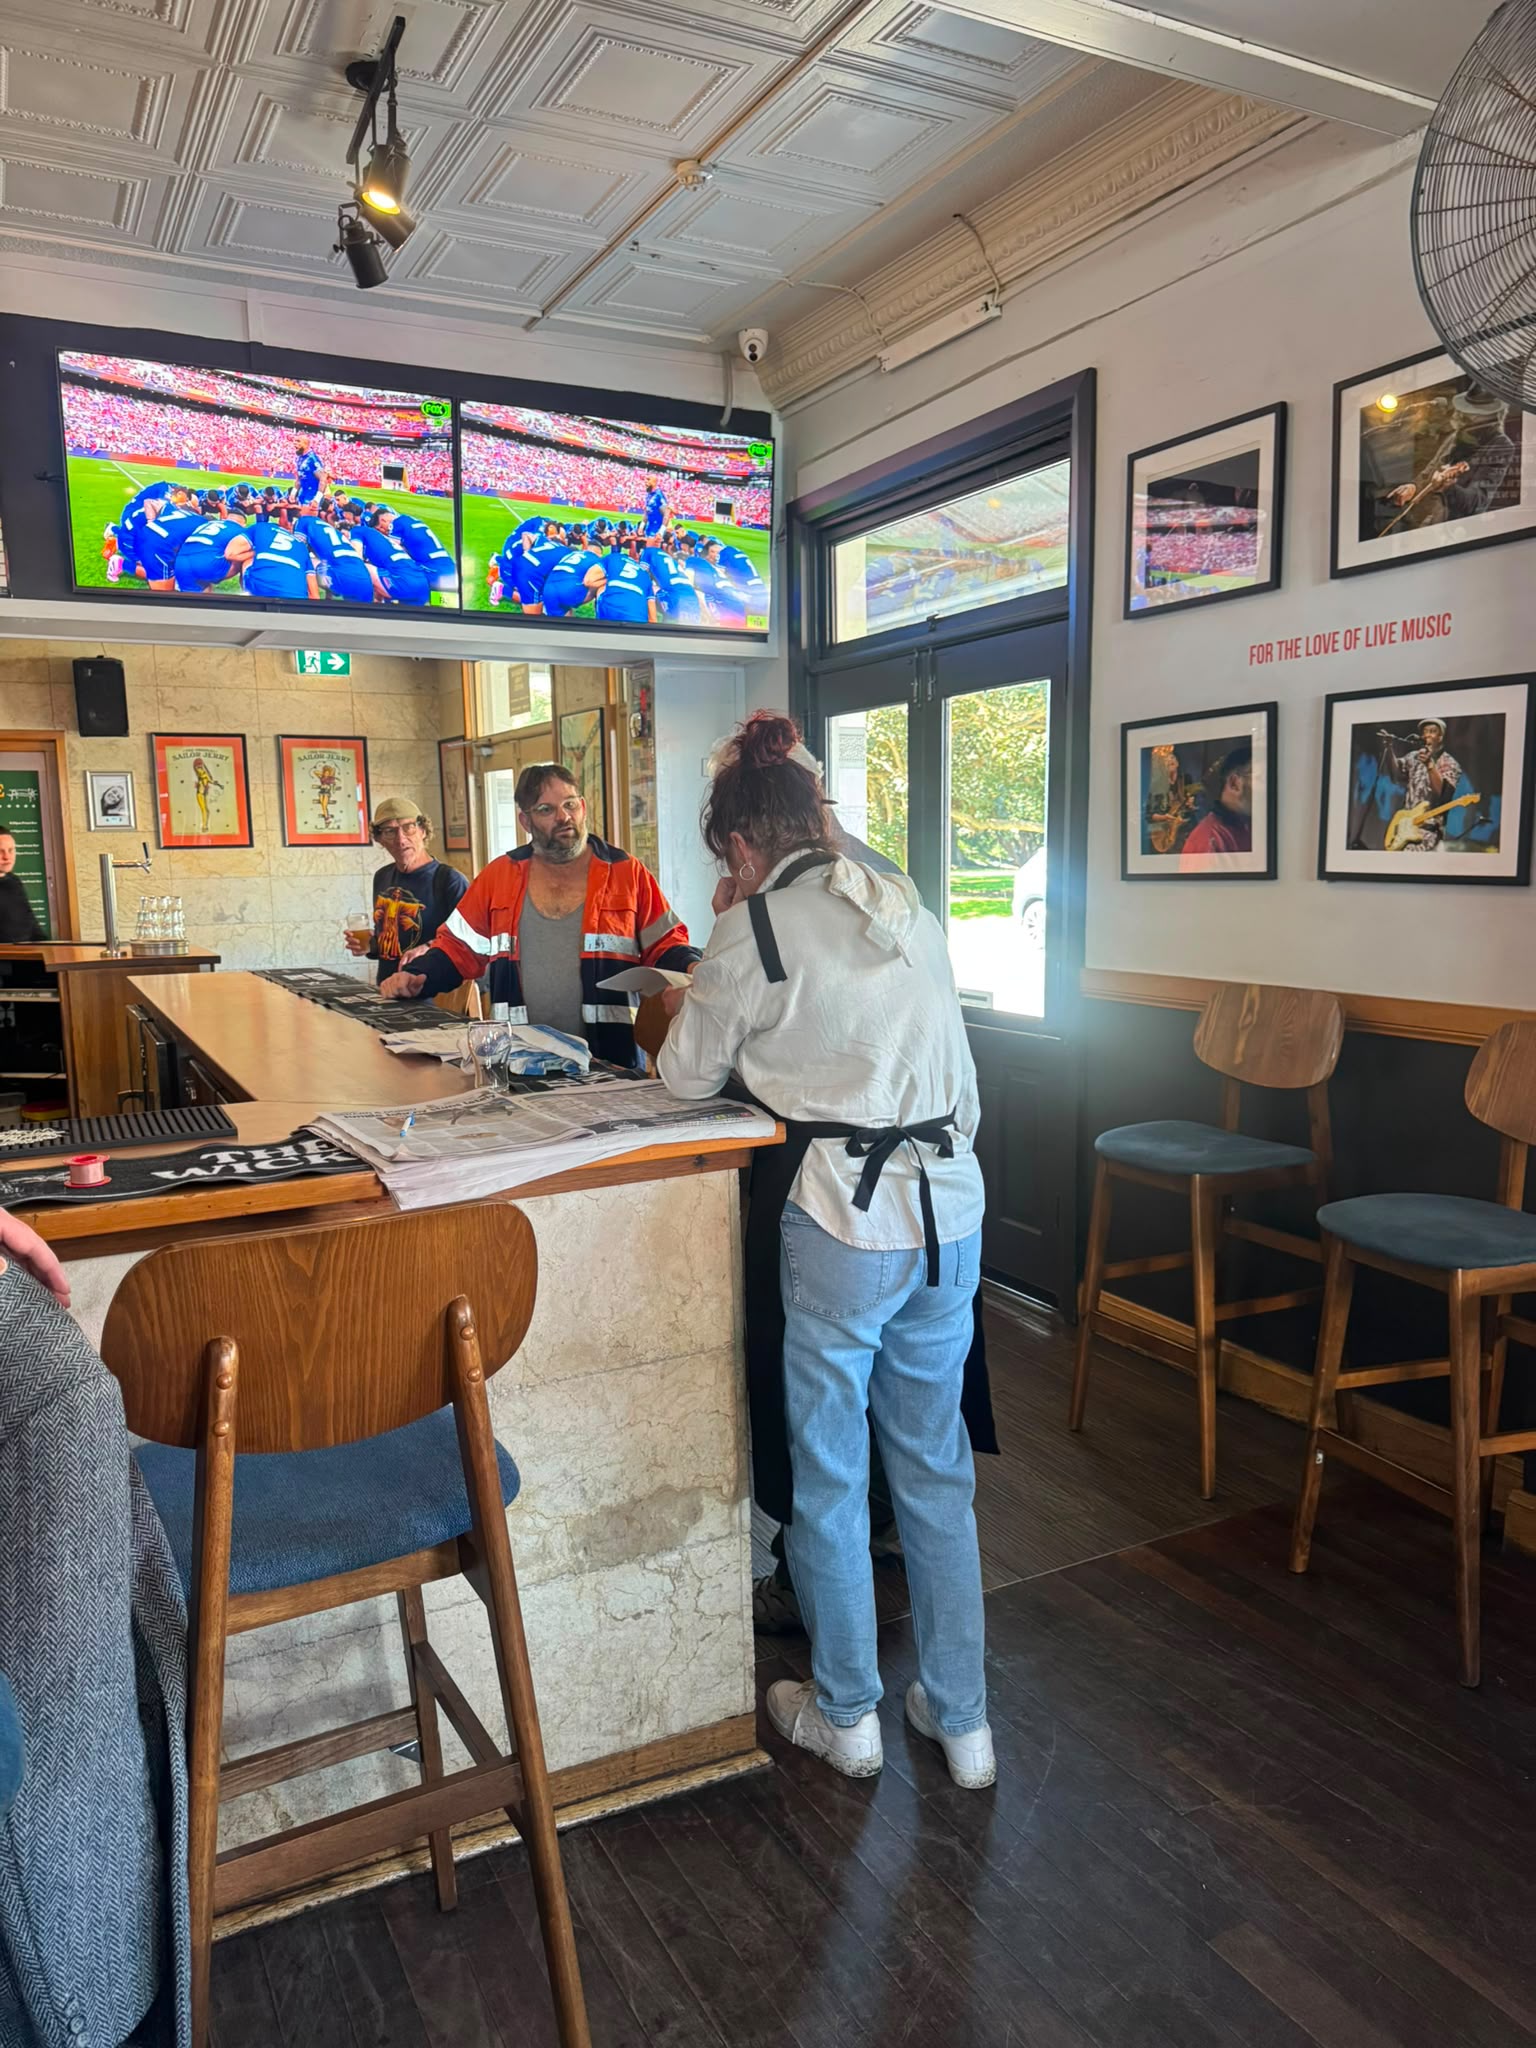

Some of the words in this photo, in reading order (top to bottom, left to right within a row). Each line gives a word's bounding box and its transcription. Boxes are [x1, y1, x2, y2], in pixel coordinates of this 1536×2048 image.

[425, 403, 445, 415] FOX
[269, 532, 295, 551] 5
[619, 562, 640, 579] 5
[1249, 642, 1274, 666] FOR
[1276, 637, 1302, 662] THE
[1305, 631, 1341, 657] LOVE
[1343, 627, 1362, 651] OF
[1365, 621, 1398, 648] LIVE
[1401, 612, 1452, 642] MUSIC
[171, 752, 201, 762] SAILOR
[202, 751, 230, 761] JERRY
[297, 753, 325, 762] SAILOR
[326, 753, 351, 764] JERRY
[199, 1139, 343, 1164] THE
